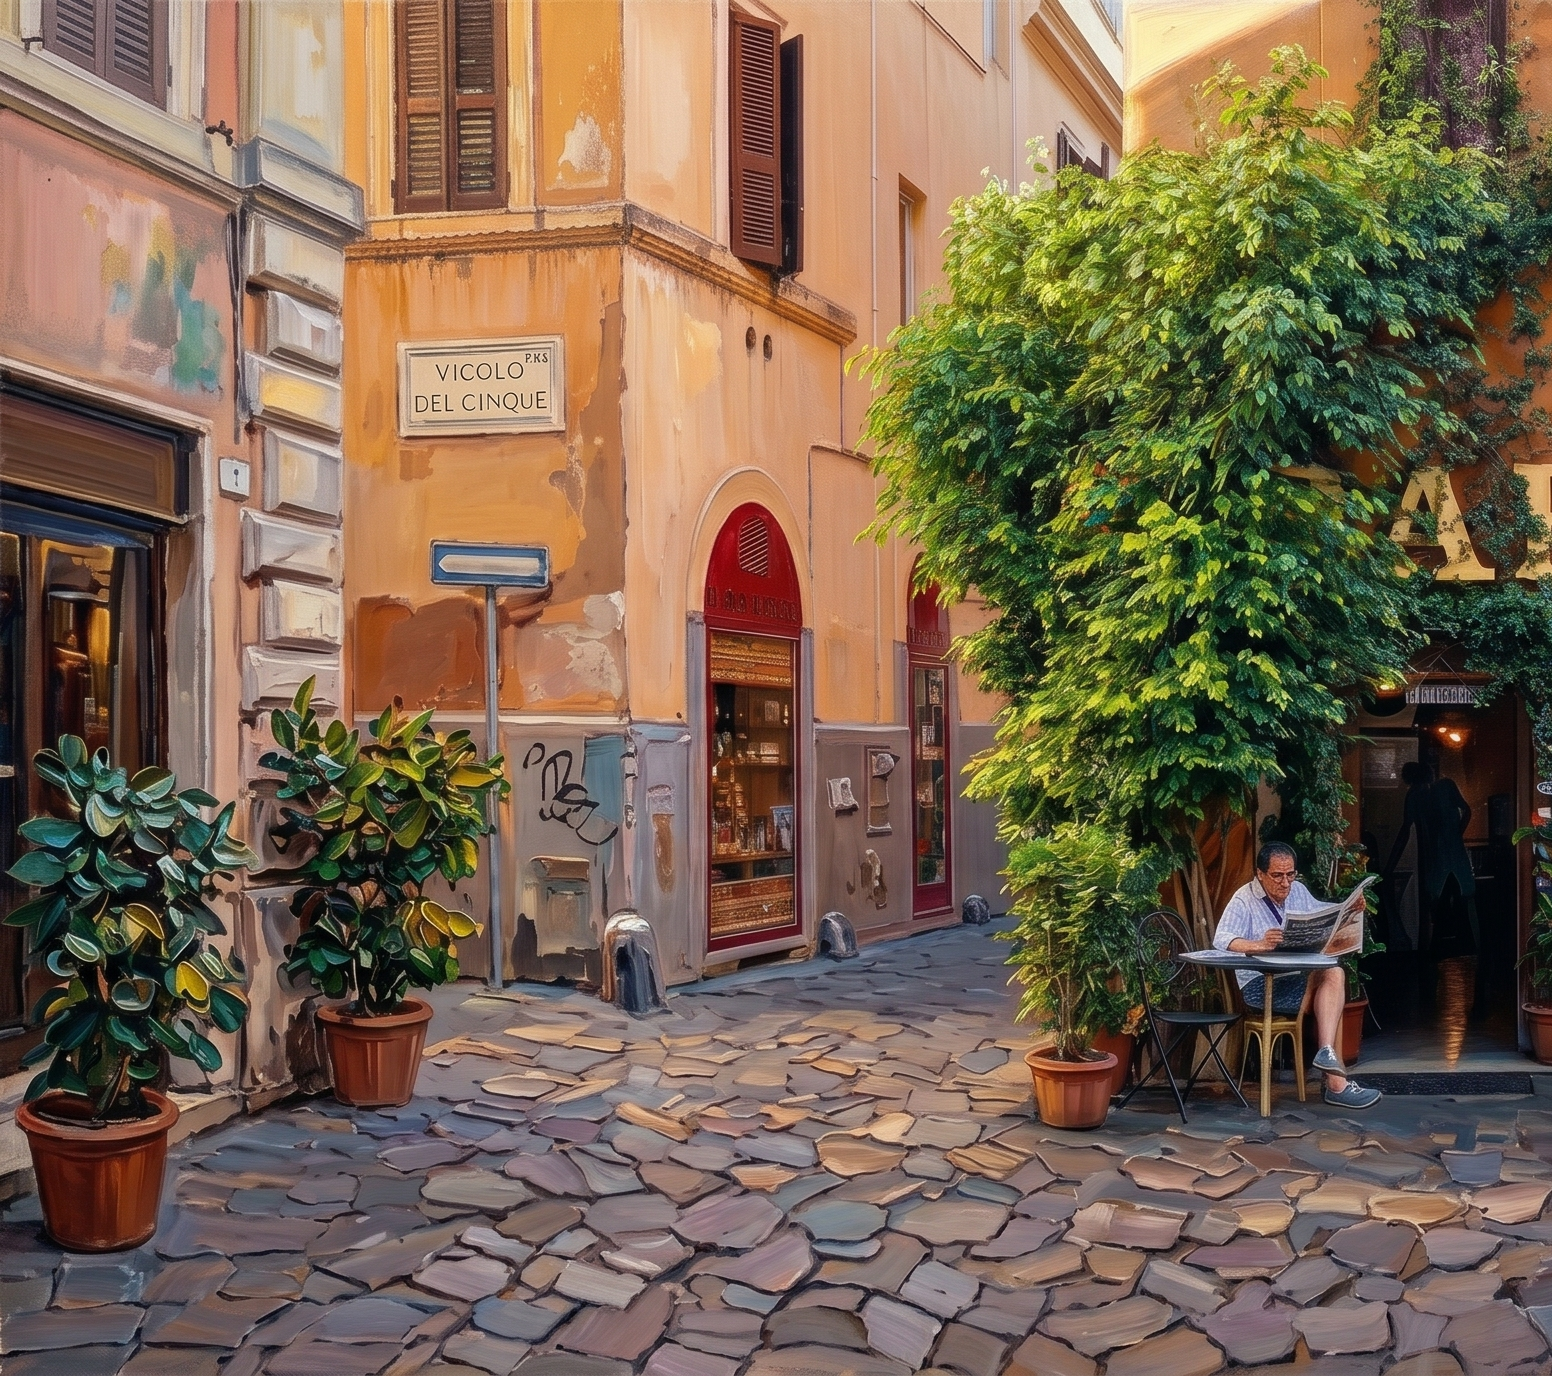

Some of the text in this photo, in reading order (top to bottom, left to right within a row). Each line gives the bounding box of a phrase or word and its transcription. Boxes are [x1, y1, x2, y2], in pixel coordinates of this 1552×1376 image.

[435, 361, 524, 382] VICOLO
[415, 391, 548, 413] DEL CINQUE
